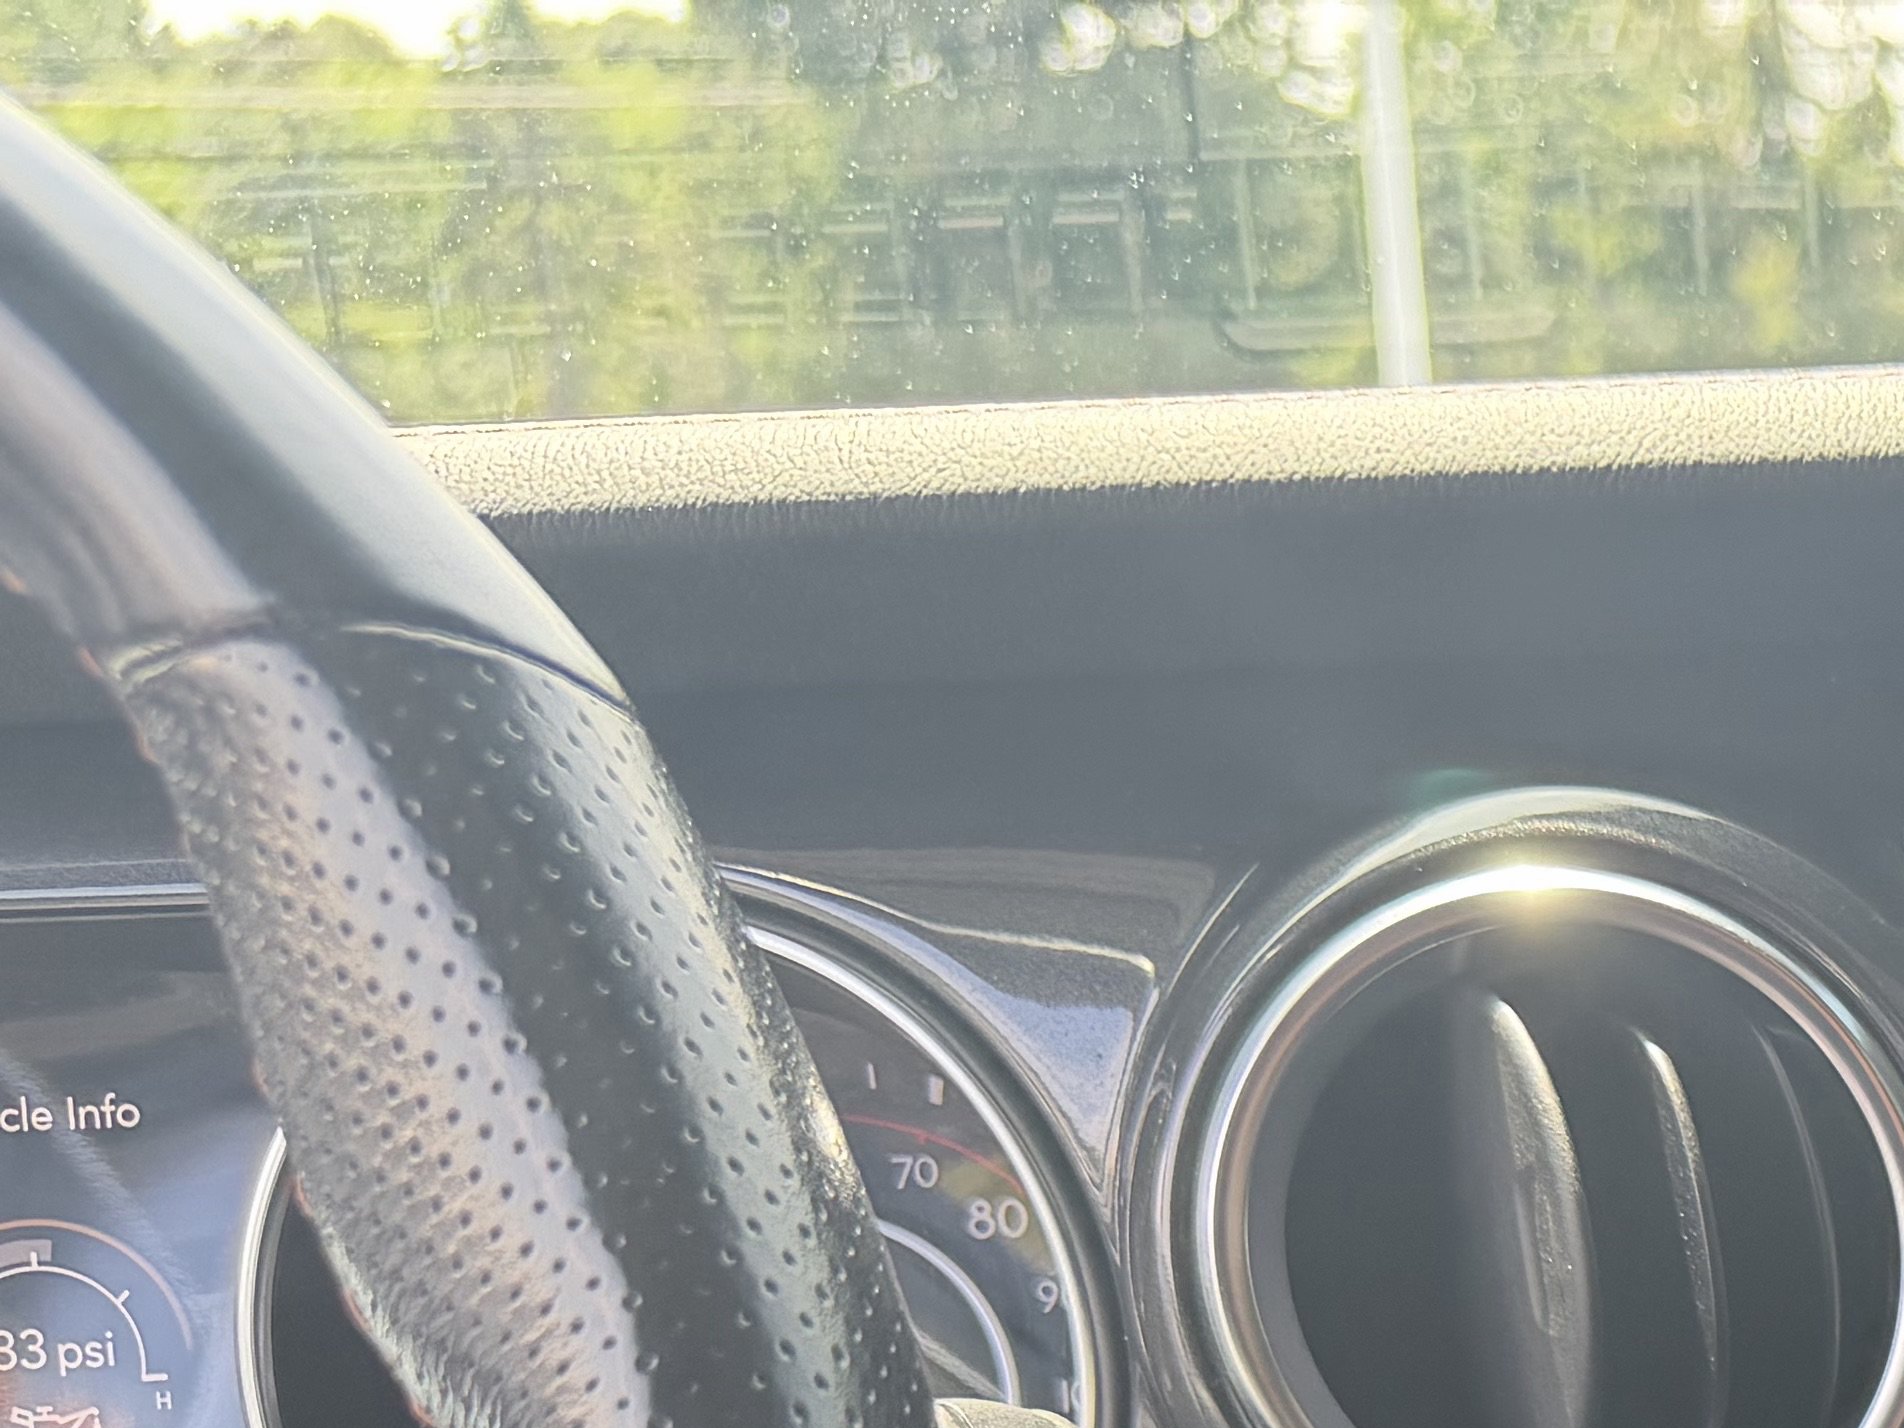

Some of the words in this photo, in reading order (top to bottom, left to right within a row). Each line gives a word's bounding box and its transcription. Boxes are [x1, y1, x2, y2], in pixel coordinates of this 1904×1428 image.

[66, 1092, 141, 1130] Info
[890, 1153, 939, 1189] 70
[967, 1196, 1028, 1240] 80
[58, 1330, 115, 1376] psi
[156, 1391, 172, 1410] H
